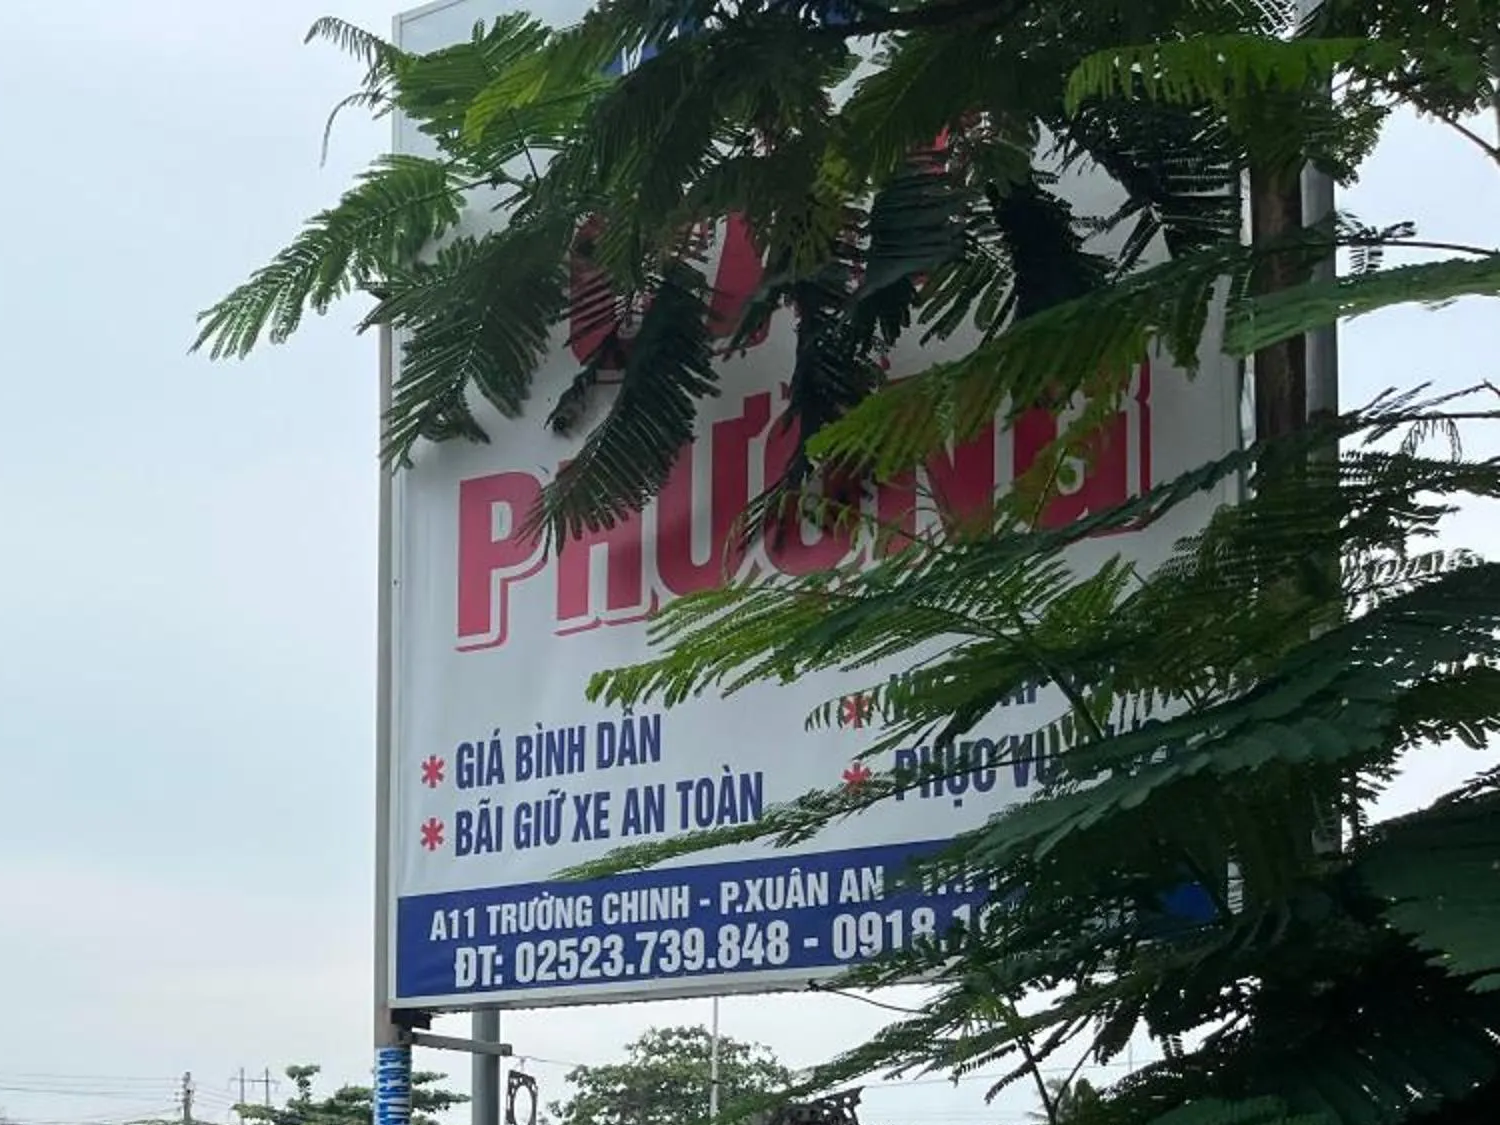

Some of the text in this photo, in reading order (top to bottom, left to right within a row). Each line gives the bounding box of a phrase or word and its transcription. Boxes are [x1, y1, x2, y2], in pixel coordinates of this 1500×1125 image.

[455, 709, 662, 790] GIÁ BÌNH DÂN
[455, 764, 764, 857] BÃI GIỮ XE AN TOÀN
[430, 906, 476, 941] A11
[486, 891, 593, 936] TRƯỜNG
[602, 885, 690, 925] CHINH
[720, 868, 828, 915] P.XUÂN
[840, 865, 885, 902] AN
[454, 944, 504, 989] ĐT:
[515, 919, 790, 984] 02523.739.848
